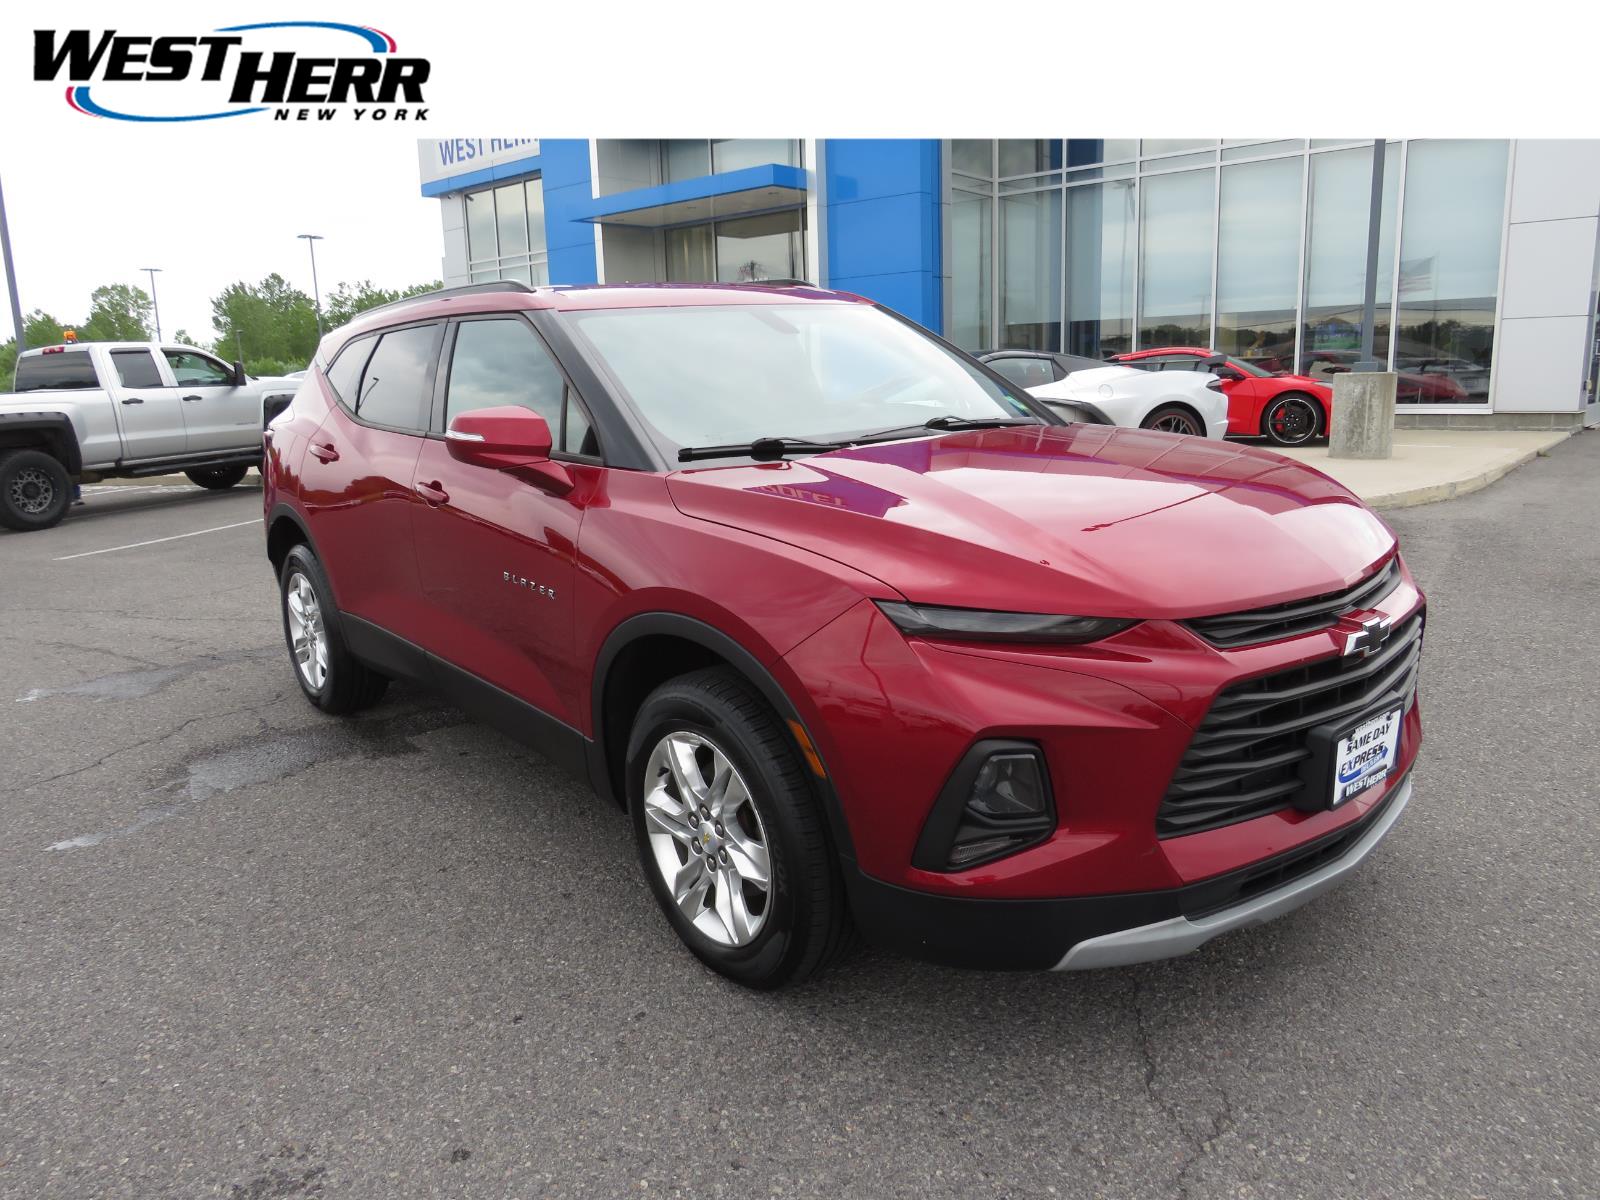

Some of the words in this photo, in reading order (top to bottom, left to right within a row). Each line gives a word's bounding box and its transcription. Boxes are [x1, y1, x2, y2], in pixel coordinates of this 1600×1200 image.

[439, 138, 484, 166] WEST
[491, 138, 539, 153] HE
[503, 571, 555, 600] BLAZER
[1346, 731, 1372, 755] SAME
[1373, 722, 1392, 741] DAY
[1341, 742, 1385, 777] EXPRESS
[1345, 775, 1368, 797] WEST
[1366, 769, 1387, 788] HERR
